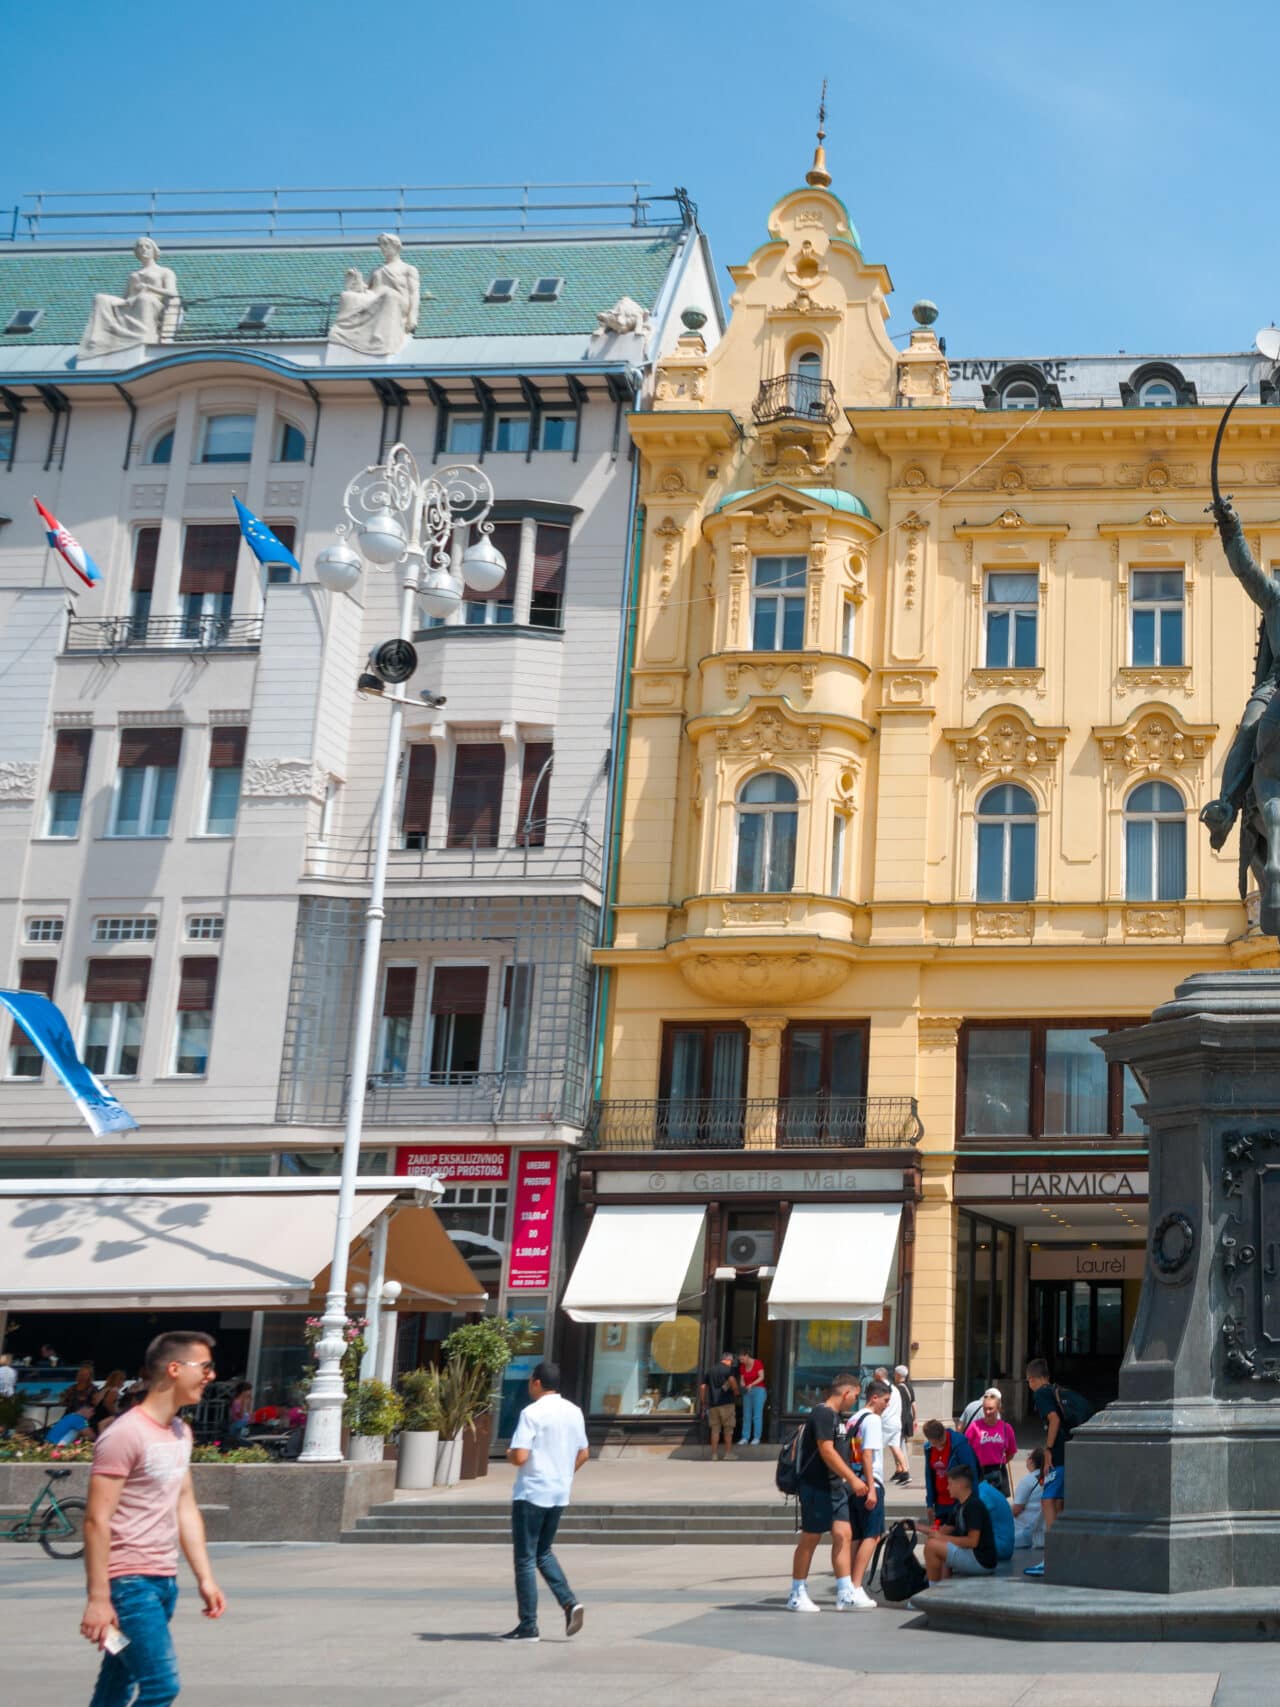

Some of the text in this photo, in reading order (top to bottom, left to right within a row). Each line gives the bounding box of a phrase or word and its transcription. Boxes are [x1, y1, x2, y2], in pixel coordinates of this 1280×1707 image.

[408, 1153, 504, 1165] ZAKUP EKSKLUZIVNOG
[457, 1165, 503, 1177] PROSTORA
[693, 1171, 857, 1191] Galerija Mala
[1011, 1173, 1135, 1197] HARMICA
